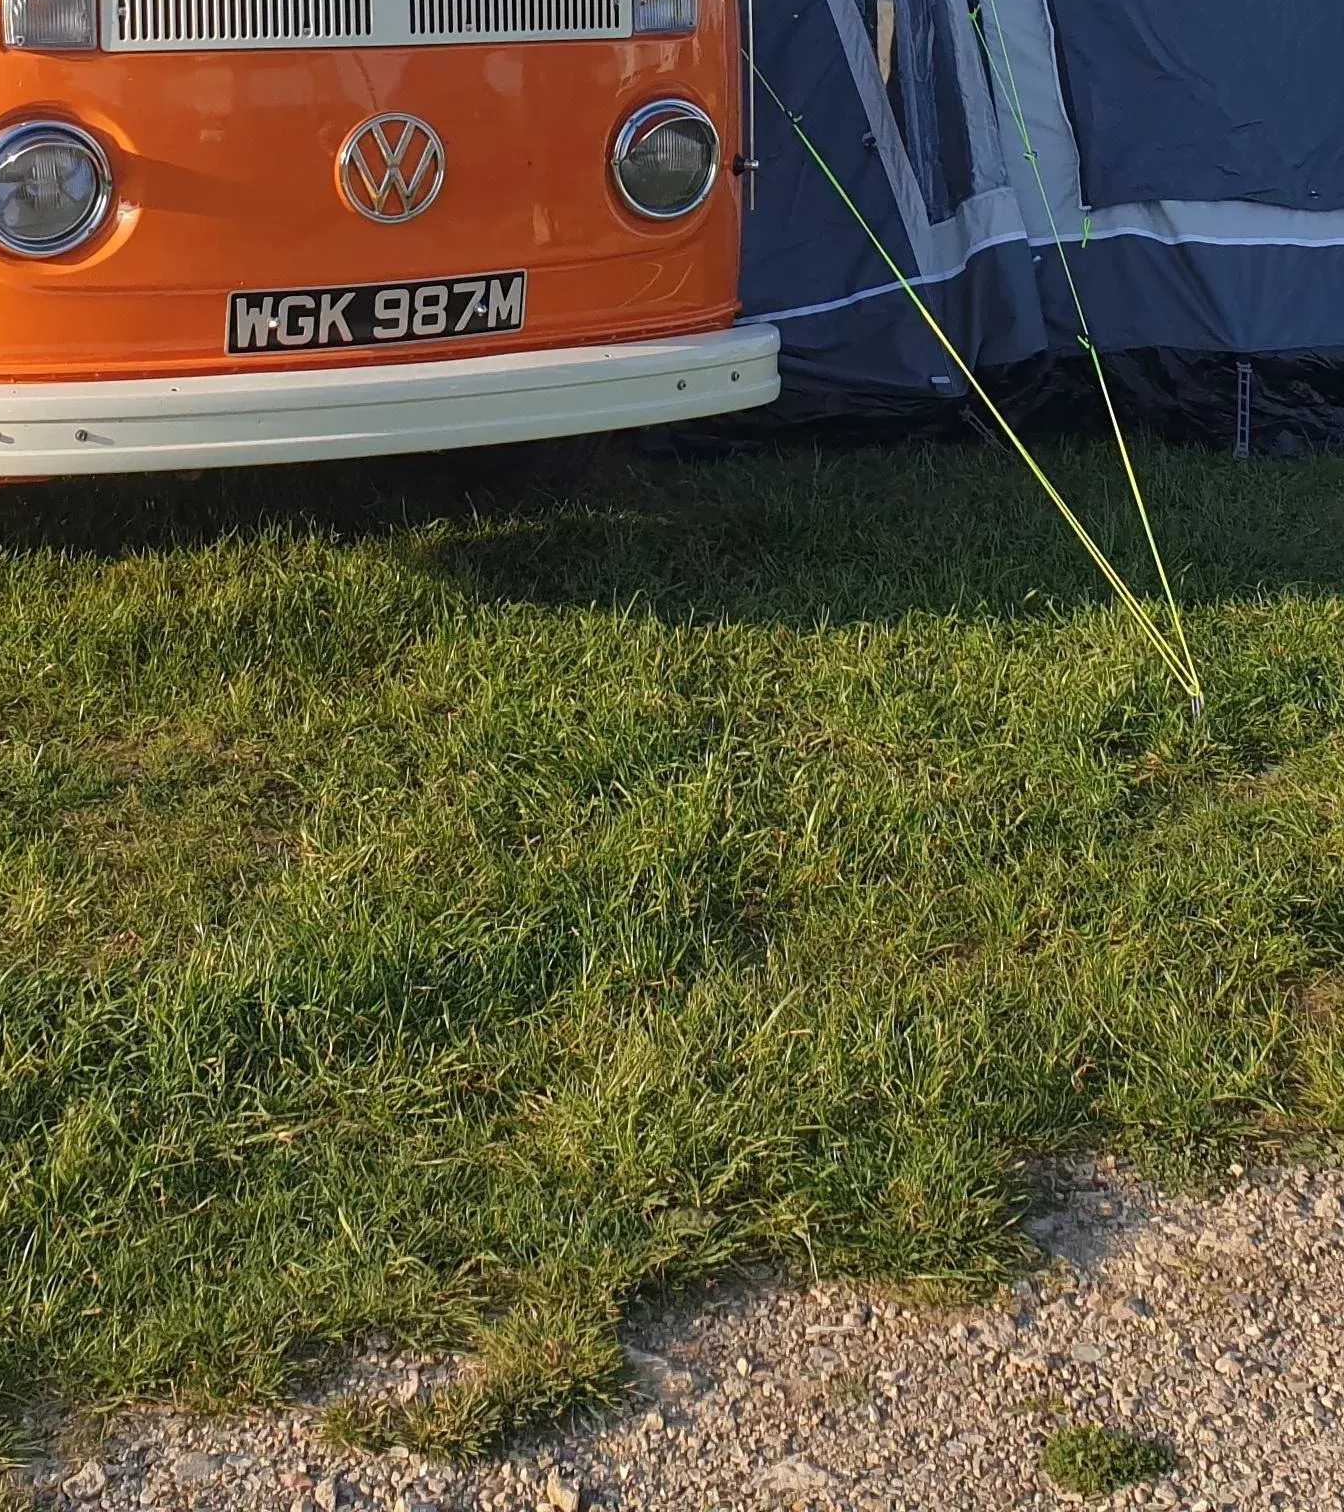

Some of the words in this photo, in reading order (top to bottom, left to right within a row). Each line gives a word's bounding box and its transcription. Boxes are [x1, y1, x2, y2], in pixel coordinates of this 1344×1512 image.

[346, 116, 440, 218] VW
[236, 292, 356, 348] WGK
[373, 277, 523, 339] 987M
